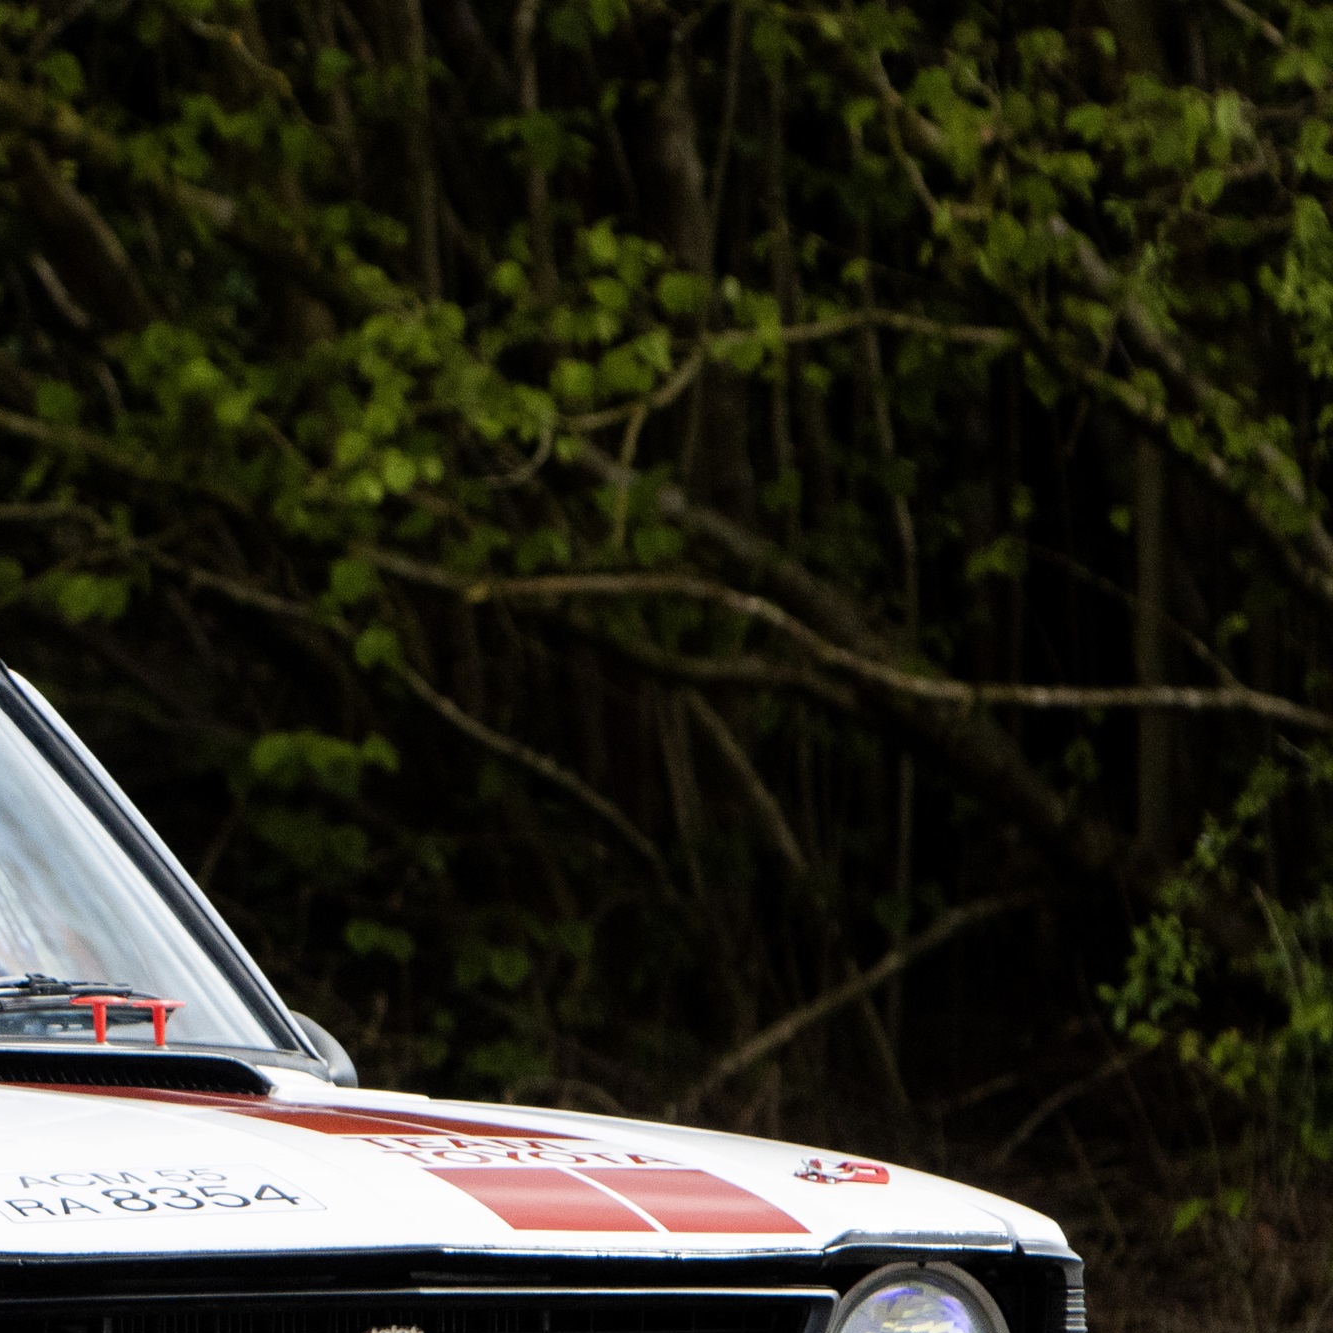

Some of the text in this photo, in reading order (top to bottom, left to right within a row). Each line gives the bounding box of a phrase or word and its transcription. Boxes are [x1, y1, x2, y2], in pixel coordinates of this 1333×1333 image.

[342, 1137, 570, 1151] TEAM
[383, 1150, 688, 1165] TOYOTA
[19, 1168, 227, 1189] ACM 55
[5, 1184, 300, 1217] RA 8354
